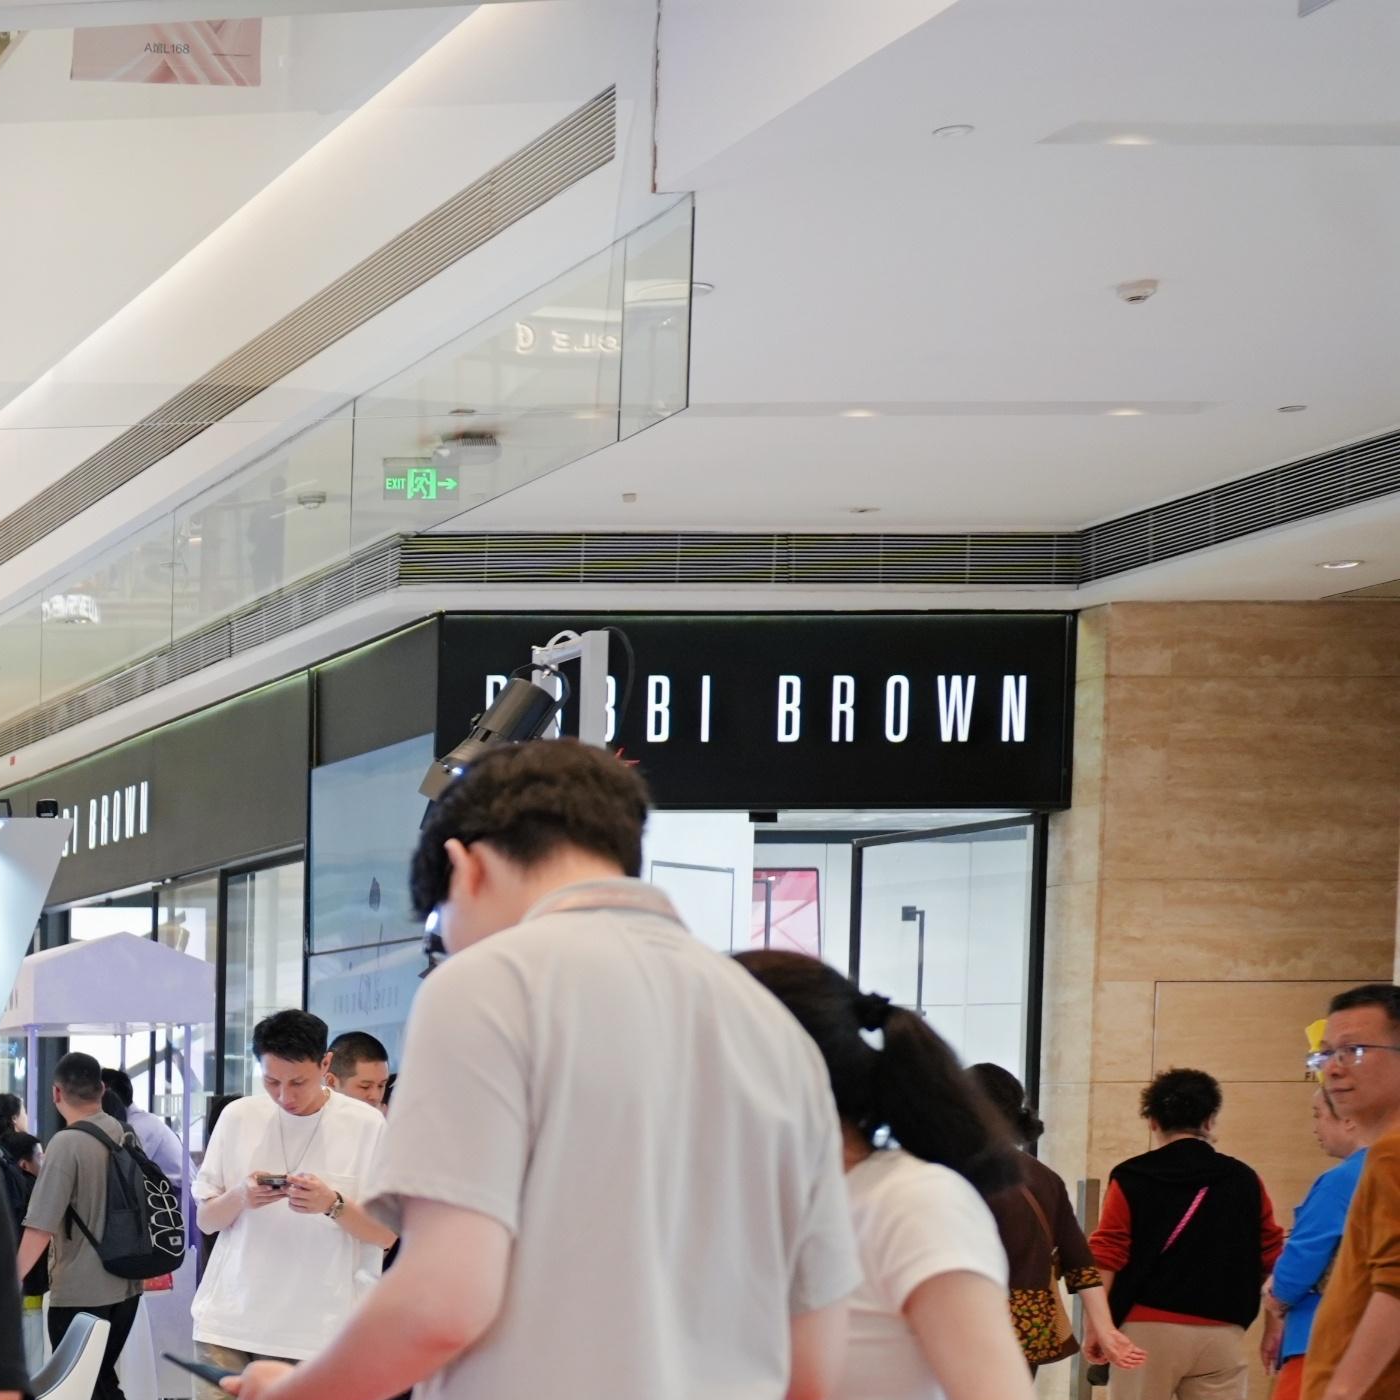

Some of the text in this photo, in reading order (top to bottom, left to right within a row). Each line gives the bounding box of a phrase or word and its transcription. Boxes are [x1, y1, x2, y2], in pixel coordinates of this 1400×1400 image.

[385, 478, 406, 490] EXIT
[777, 674, 1028, 743] BROWN
[88, 781, 149, 850] BROWN
